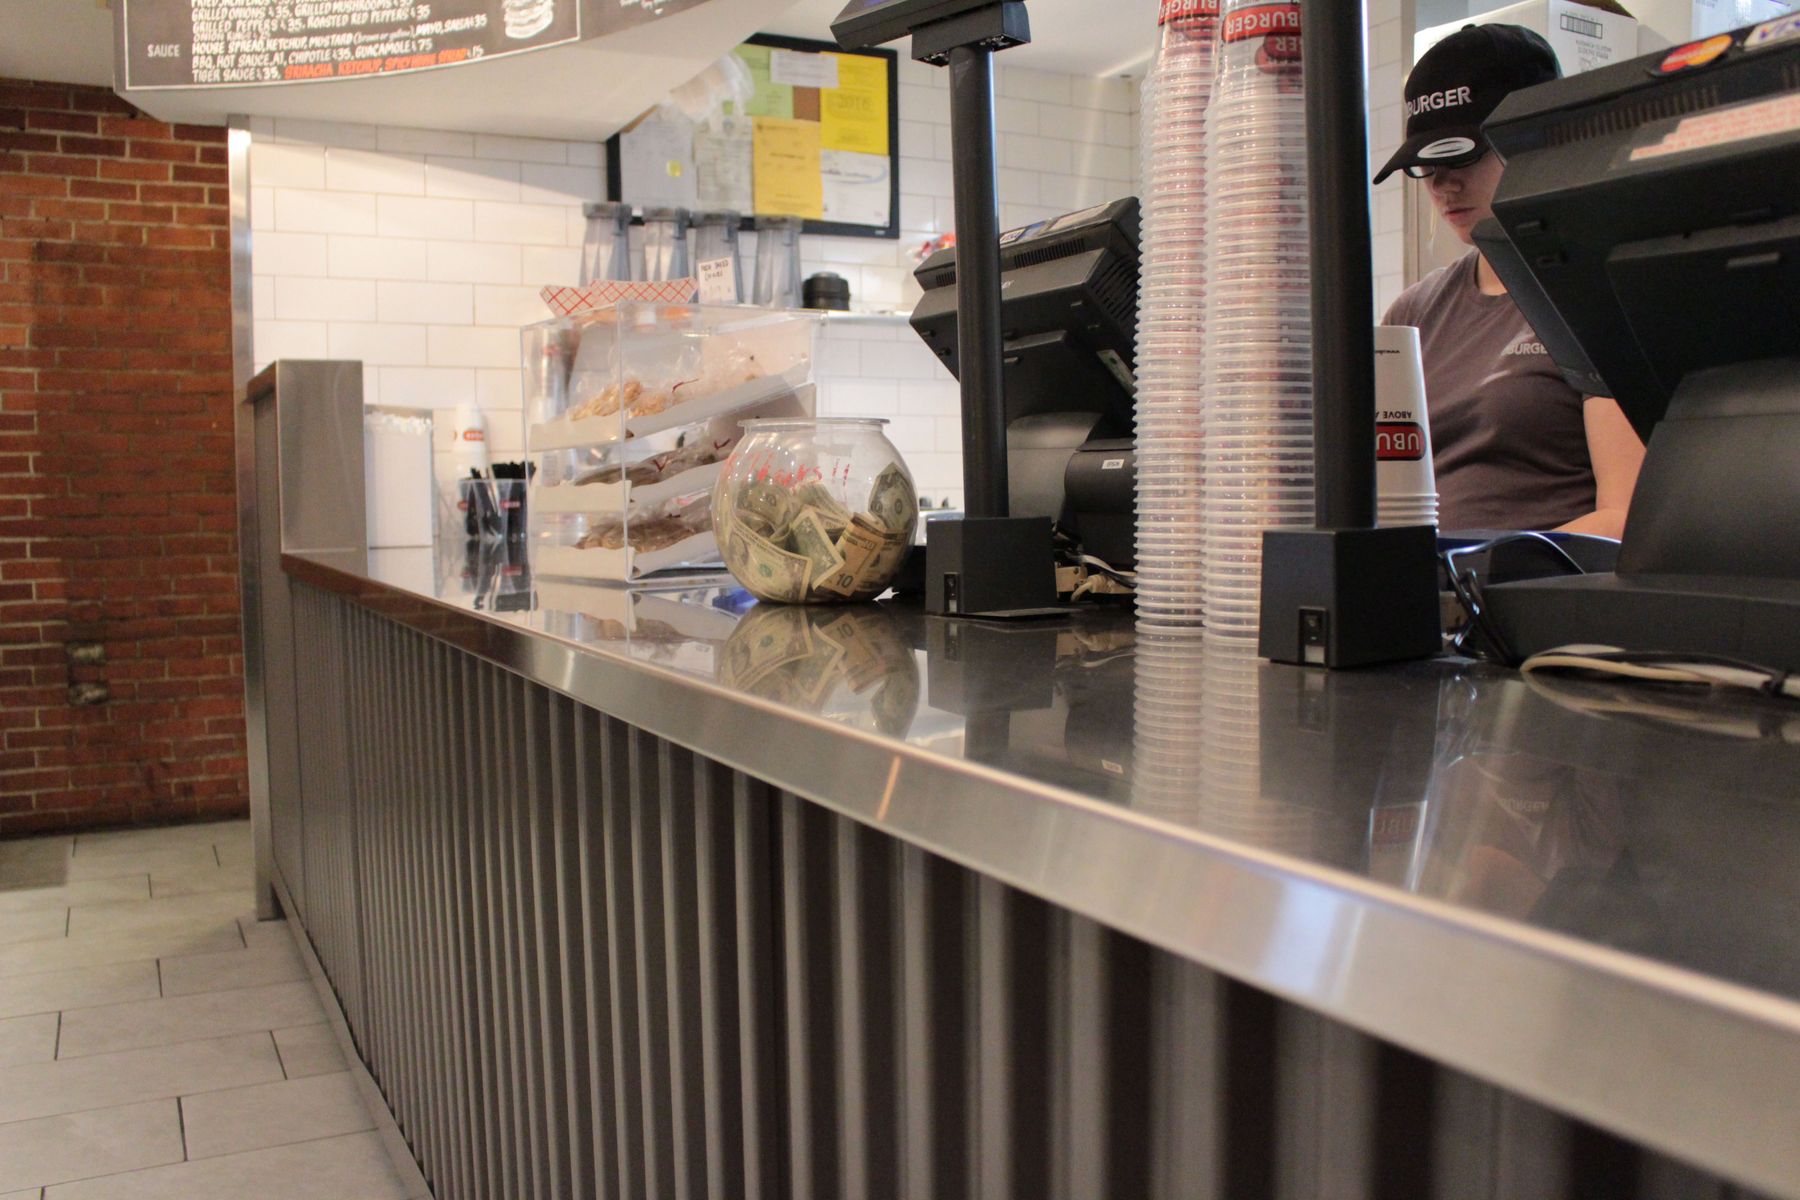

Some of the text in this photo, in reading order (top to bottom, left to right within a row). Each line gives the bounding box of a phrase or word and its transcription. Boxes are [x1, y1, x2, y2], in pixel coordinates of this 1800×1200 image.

[192, 8, 228, 21] GRILLED
[228, 6, 267, 20] ONIONS
[295, 2, 332, 17] GRILLED
[192, 20, 232, 34] GRILLED
[236, 18, 279, 33] PEPPERS
[1227, 11, 1299, 34] BURGER
[147, 43, 181, 58] SAUCE
[191, 41, 225, 55] HOUSE
[309, 32, 354, 48] MUSTARD
[217, 54, 236, 68] HOT
[288, 49, 332, 64] CHIPOTLE
[192, 69, 221, 82] TIGER
[223, 66, 256, 81] SAUCE
[1406, 86, 1472, 117] BURGER
[1505, 342, 1548, 355] BURGE
[1383, 411, 1412, 419] ABOVE
[1376, 432, 1420, 450] UBU
[836, 573, 853, 588] 10
